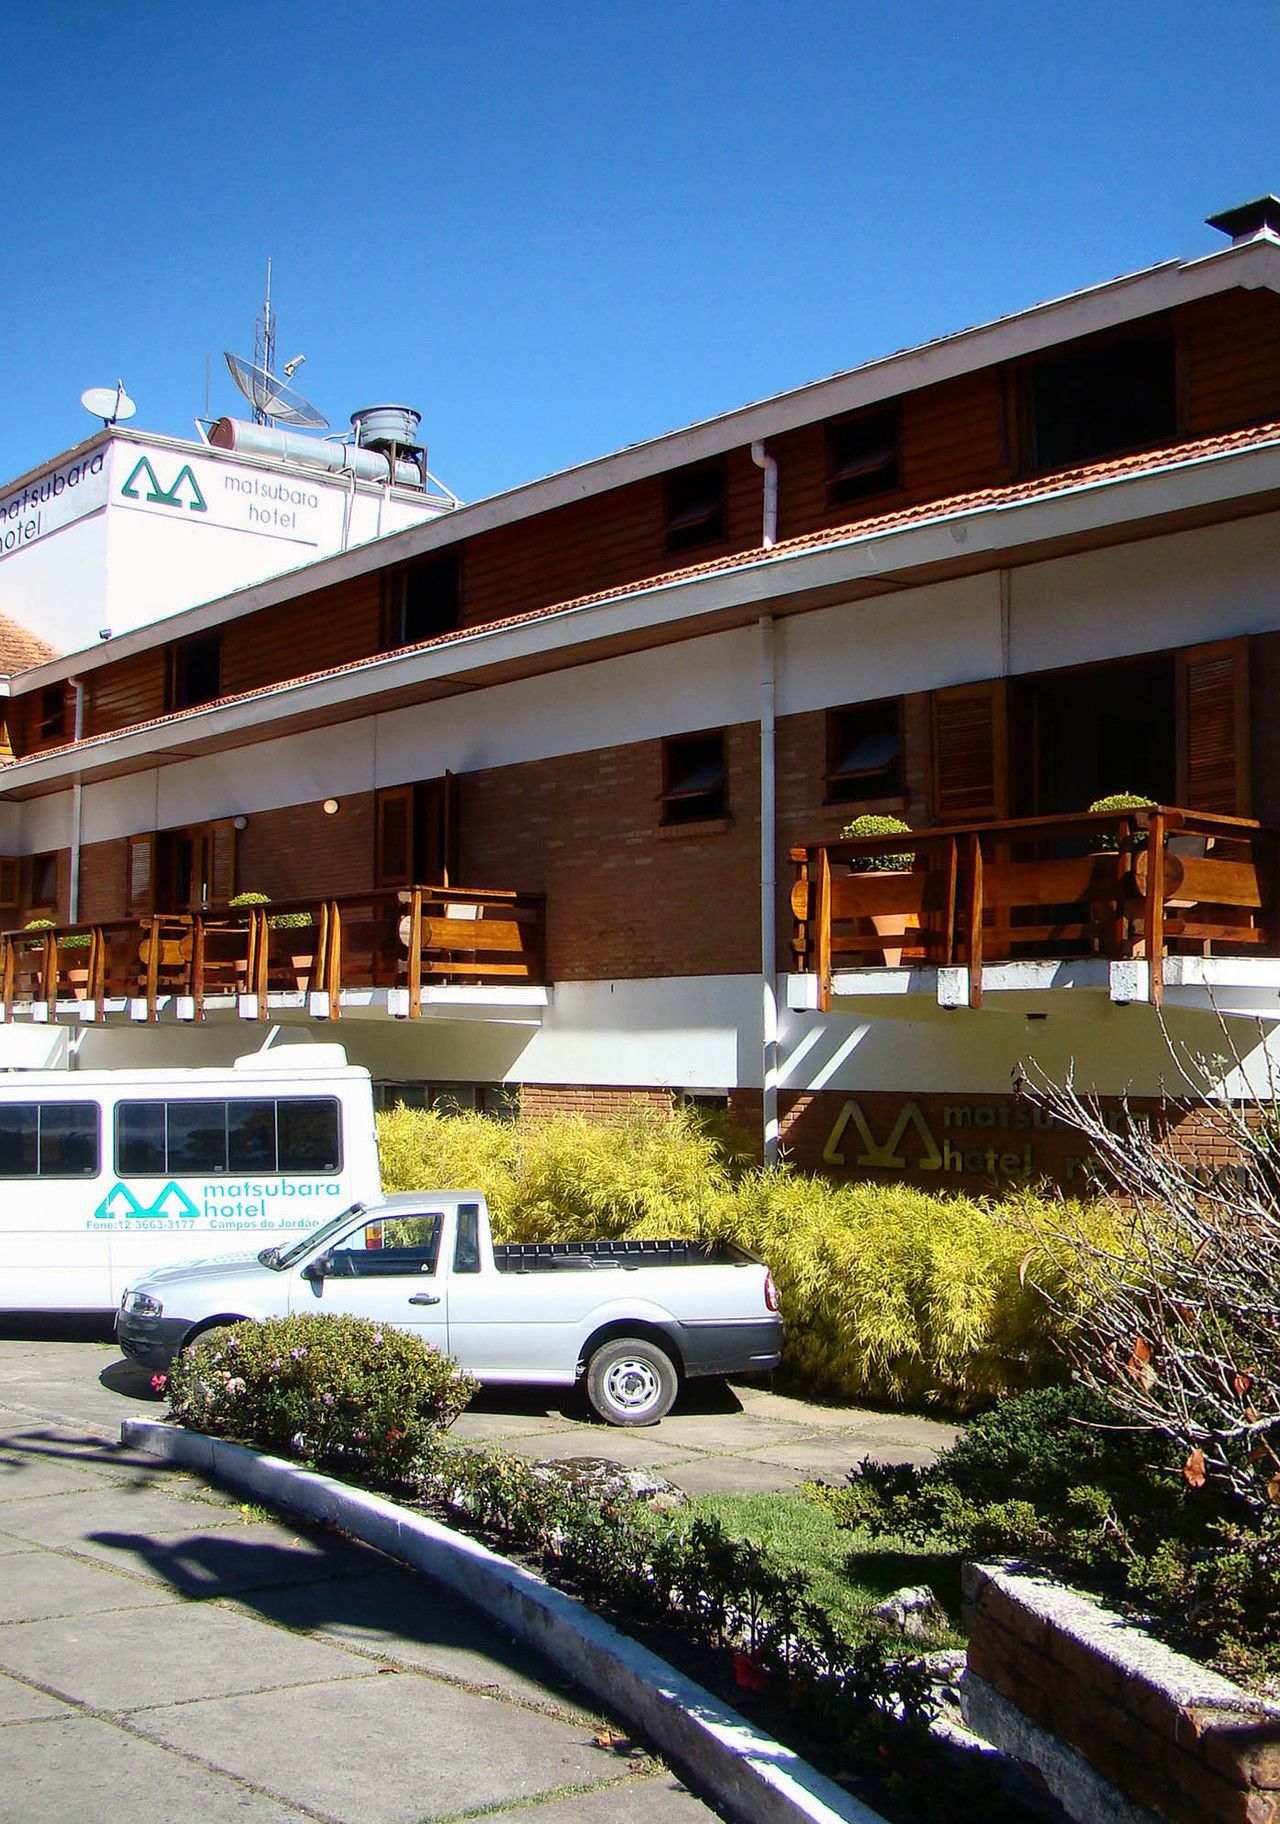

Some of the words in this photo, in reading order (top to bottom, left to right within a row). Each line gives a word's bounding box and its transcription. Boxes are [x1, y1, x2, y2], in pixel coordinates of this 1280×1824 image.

[225, 475, 318, 508] matsubara
[248, 503, 296, 529] hotel
[943, 1101, 1150, 1130] matsur
[943, 1139, 1034, 1175] hotel
[204, 1178, 340, 1197] matsubara
[204, 1199, 265, 1217] hotel
[209, 1219, 257, 1231] Campos
[260, 1219, 275, 1228] do
